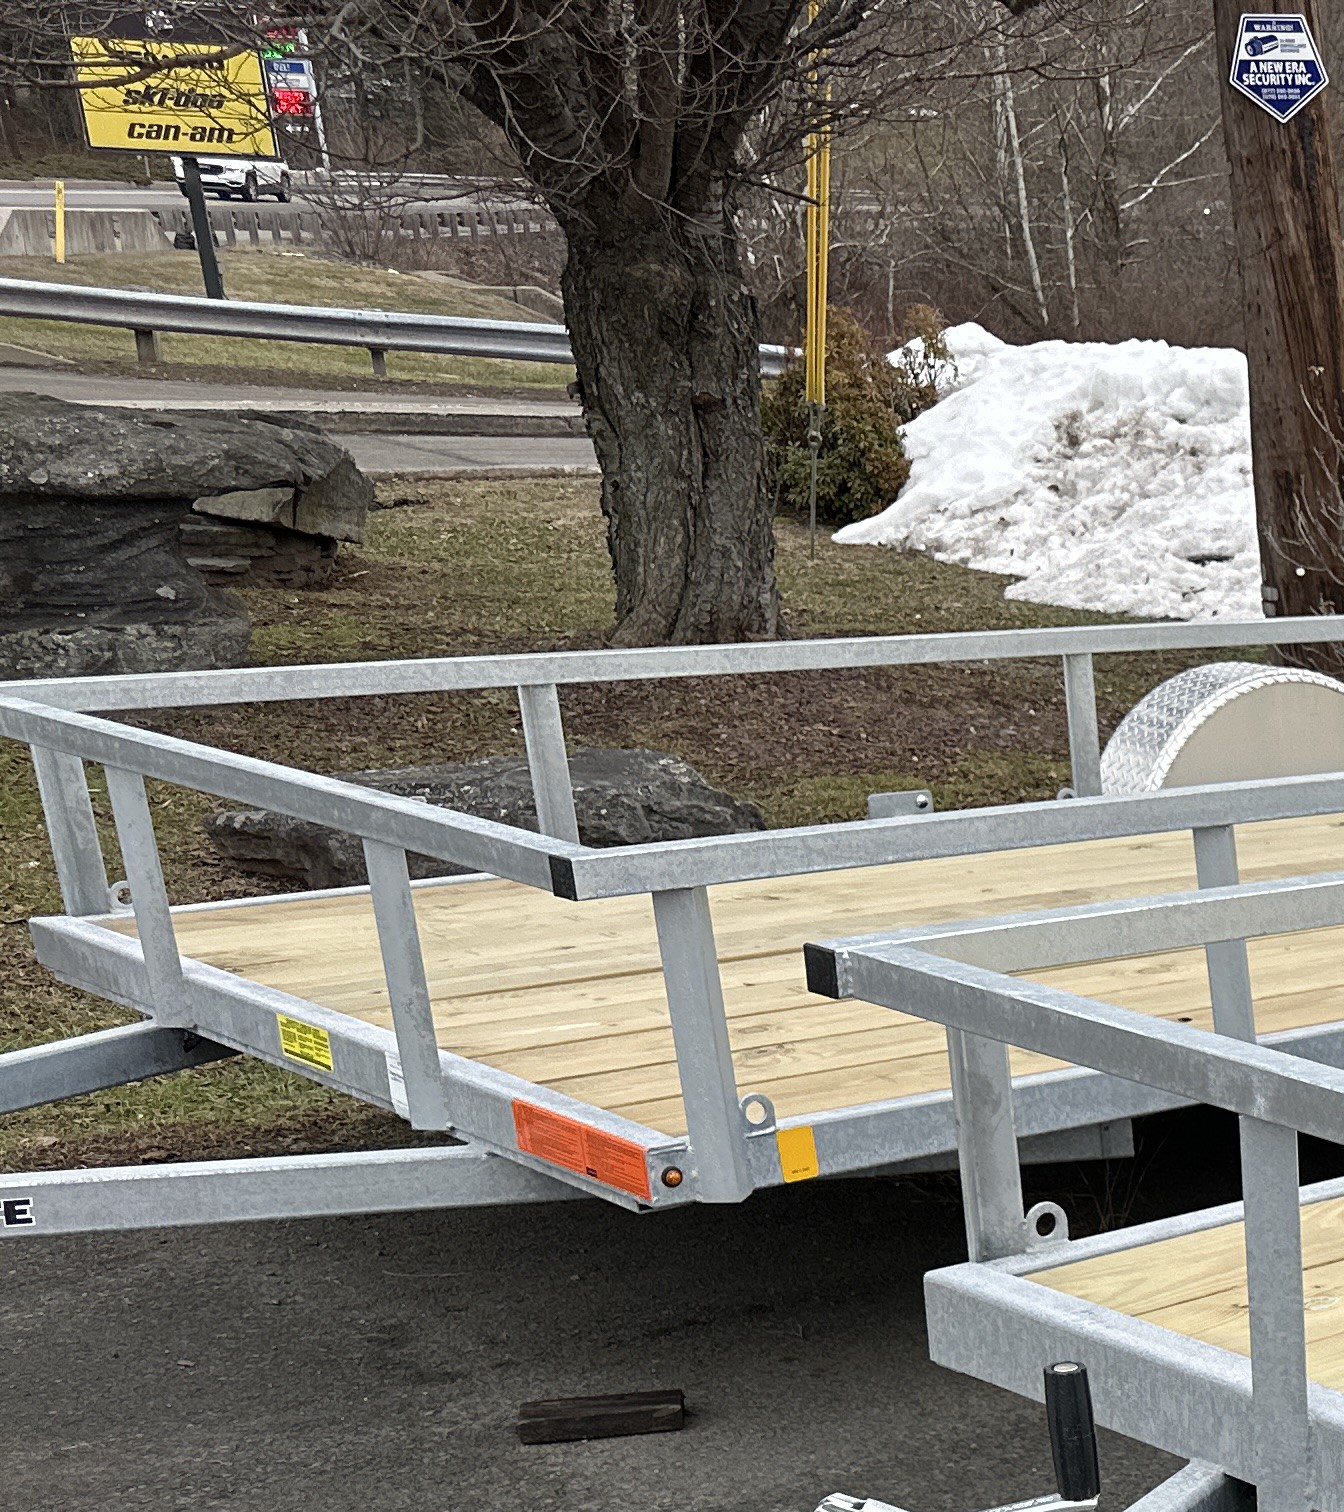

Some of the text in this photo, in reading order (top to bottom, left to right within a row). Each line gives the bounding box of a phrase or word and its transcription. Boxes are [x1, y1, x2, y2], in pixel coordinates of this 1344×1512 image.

[1250, 62, 1306, 73] A NEW ERA
[1242, 74, 1315, 85] SECURITY INC.
[128, 122, 235, 144] can-am
